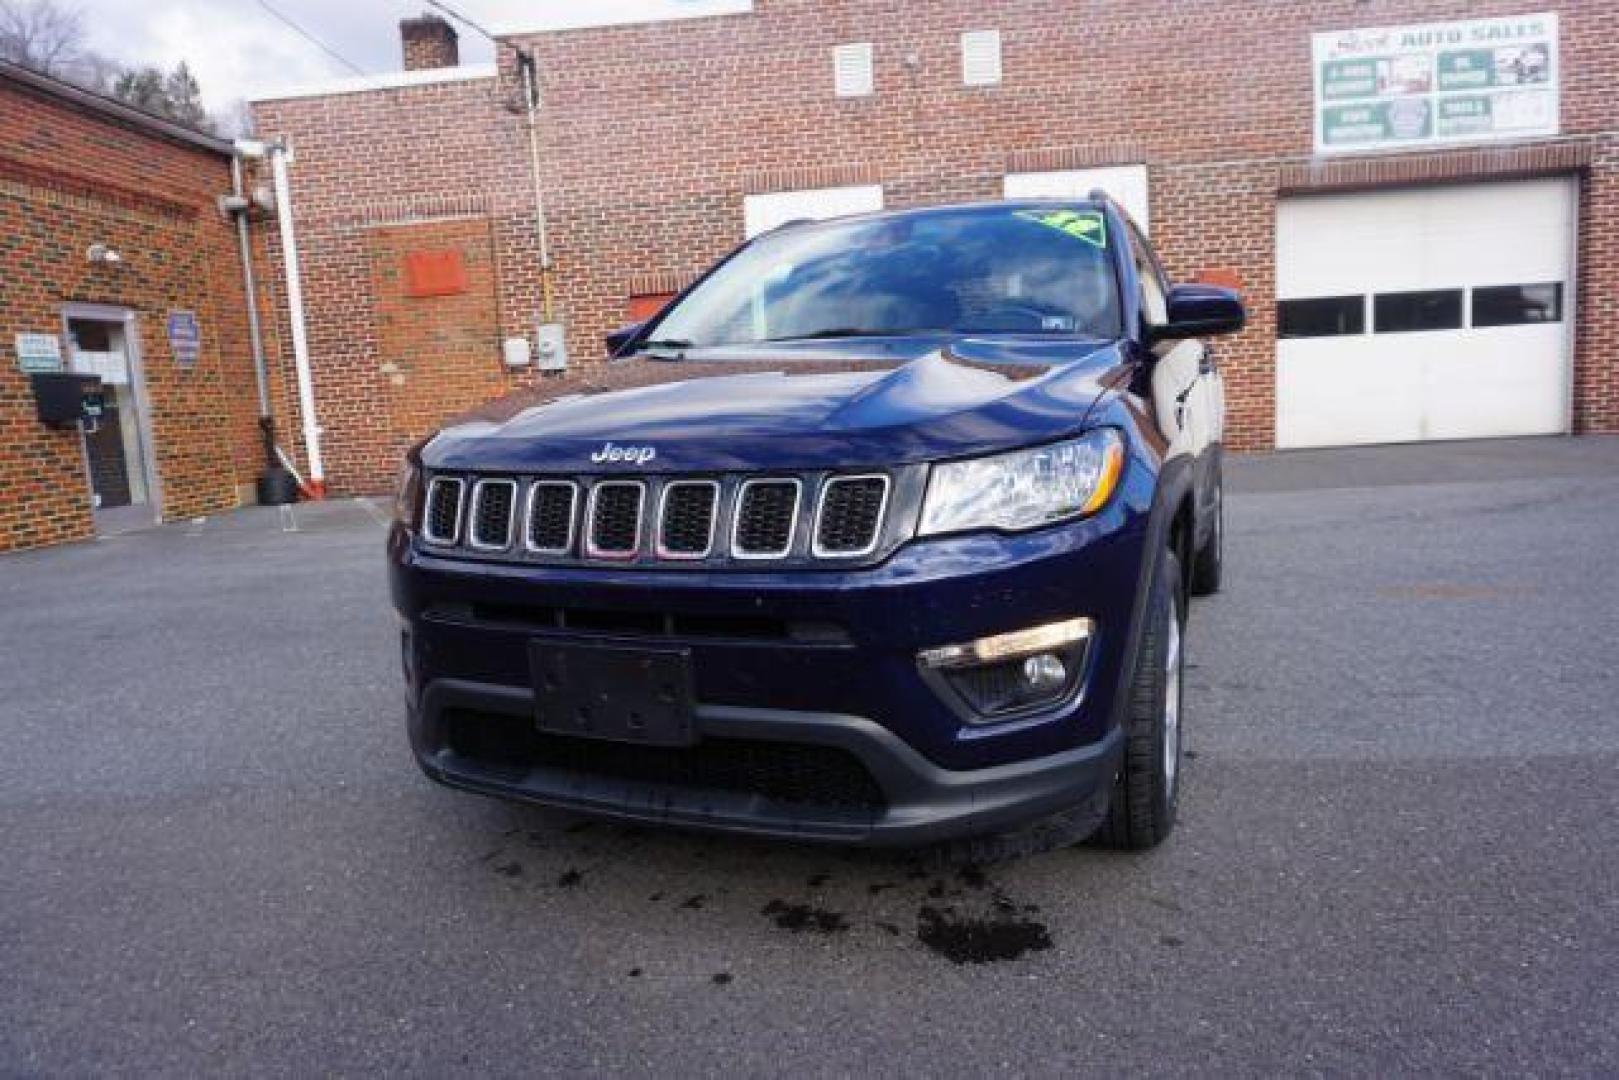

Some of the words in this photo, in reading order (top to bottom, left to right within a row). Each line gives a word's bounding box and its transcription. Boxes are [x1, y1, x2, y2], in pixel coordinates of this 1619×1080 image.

[1401, 29, 1462, 46] AUTO
[1471, 21, 1544, 40] SALES
[591, 442, 656, 465] Jeep
